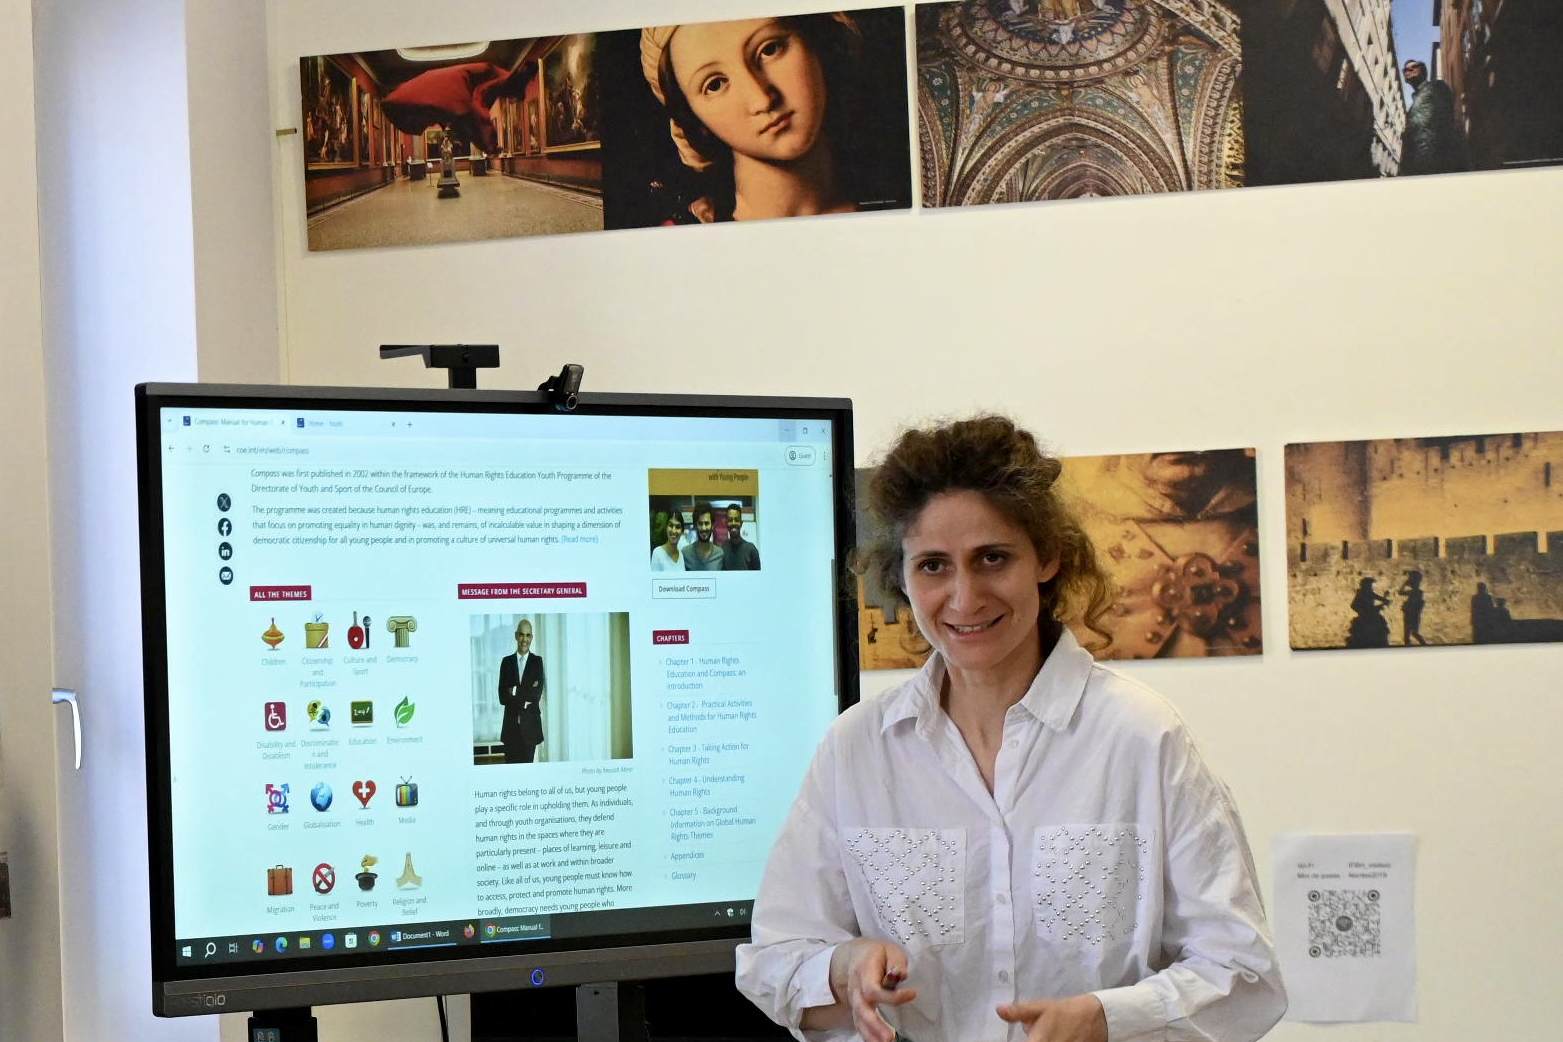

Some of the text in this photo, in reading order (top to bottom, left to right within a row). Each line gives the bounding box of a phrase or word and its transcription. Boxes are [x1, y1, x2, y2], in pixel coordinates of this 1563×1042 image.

[251, 469, 593, 482] Compass first published 2002 within framework Human Rights Education Youth Programme
[720, 474, 733, 482] Young
[734, 474, 749, 482] People
[251, 484, 433, 495] Directorate Youth Sport Council Europe.
[266, 505, 623, 516] programme created because human rights education (HRE) meaning educational programmes activities
[253, 534, 598, 546] democratic citizenship young people promoting culture universal human rights. (Read more)
[687, 585, 709, 593] Compass
[474, 783, 628, 799] Human rights belong young people
[474, 797, 633, 815] play specific role upholding them. individuals,
[488, 812, 615, 829] through youth organisations, they defend
[475, 828, 593, 843] human rights spaces where they
[476, 841, 618, 859] particularly present places learning, leisure
[476, 856, 614, 872] online well work within broader
[477, 870, 617, 888] society. Like young people must know
[485, 883, 633, 901] access, protect promote human rights. More
[267, 905, 295, 915] Migration
[310, 903, 325, 911] Peace
[478, 899, 600, 918] broadly, democracy needs young people
[313, 914, 337, 922] Violence
[403, 930, 449, 940] Document1 Word
[497, 926, 519, 934] Compass
